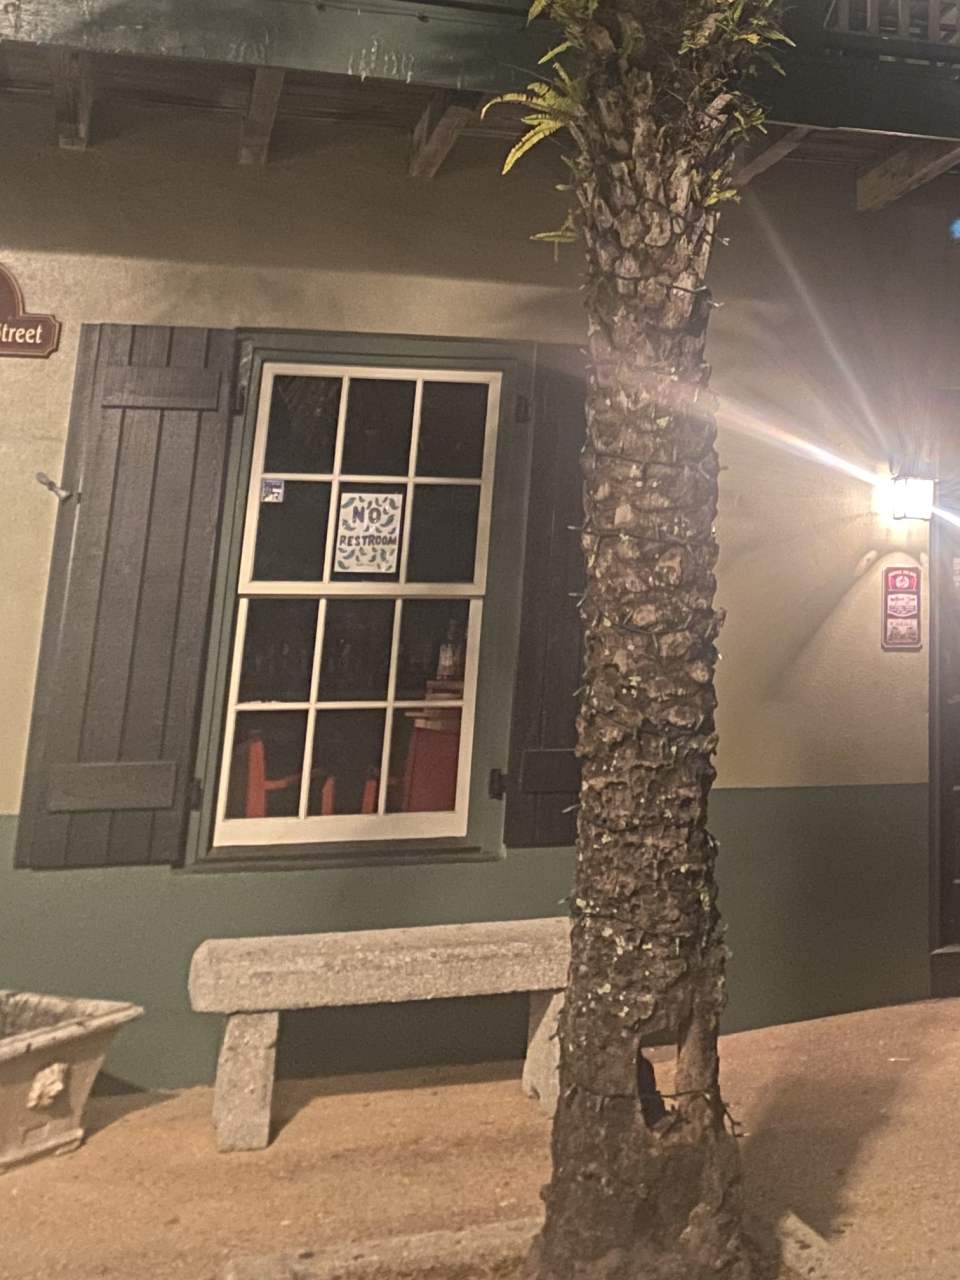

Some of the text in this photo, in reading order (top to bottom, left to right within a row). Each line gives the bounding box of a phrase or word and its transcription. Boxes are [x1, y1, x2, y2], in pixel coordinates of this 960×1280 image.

[0, 323, 42, 344] treet
[352, 505, 382, 524] NO
[339, 534, 398, 548] RESTROOM
